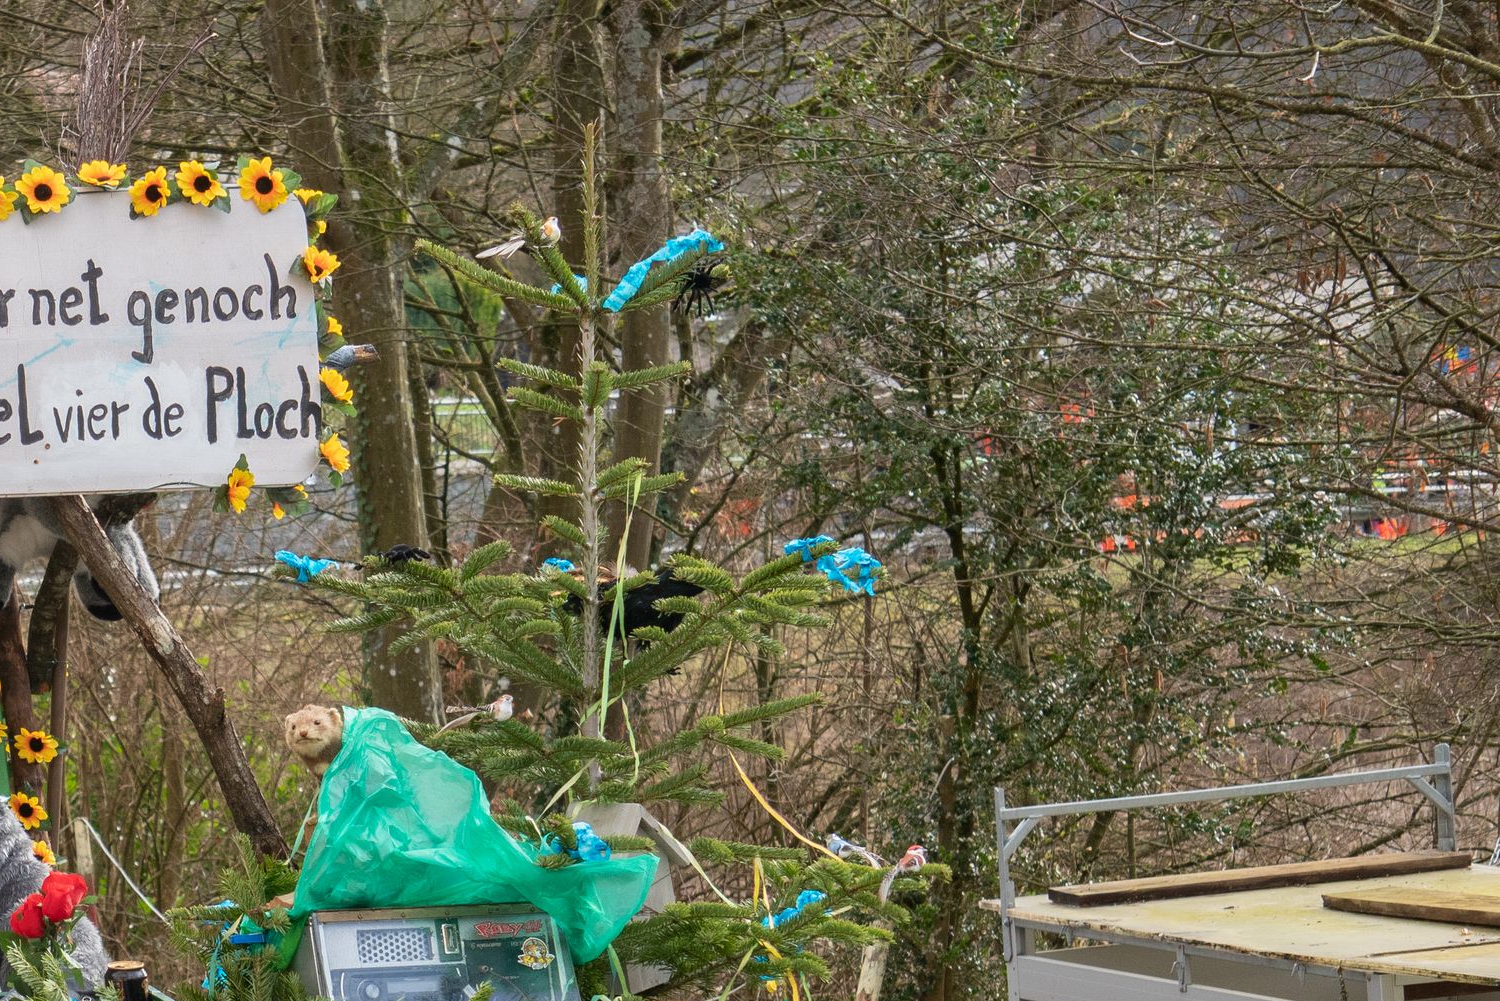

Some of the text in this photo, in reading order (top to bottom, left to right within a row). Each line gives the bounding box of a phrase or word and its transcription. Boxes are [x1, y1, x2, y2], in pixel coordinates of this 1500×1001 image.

[30, 258, 110, 326] net
[126, 252, 297, 364] genoch
[52, 388, 130, 443] vier
[142, 375, 184, 440] de
